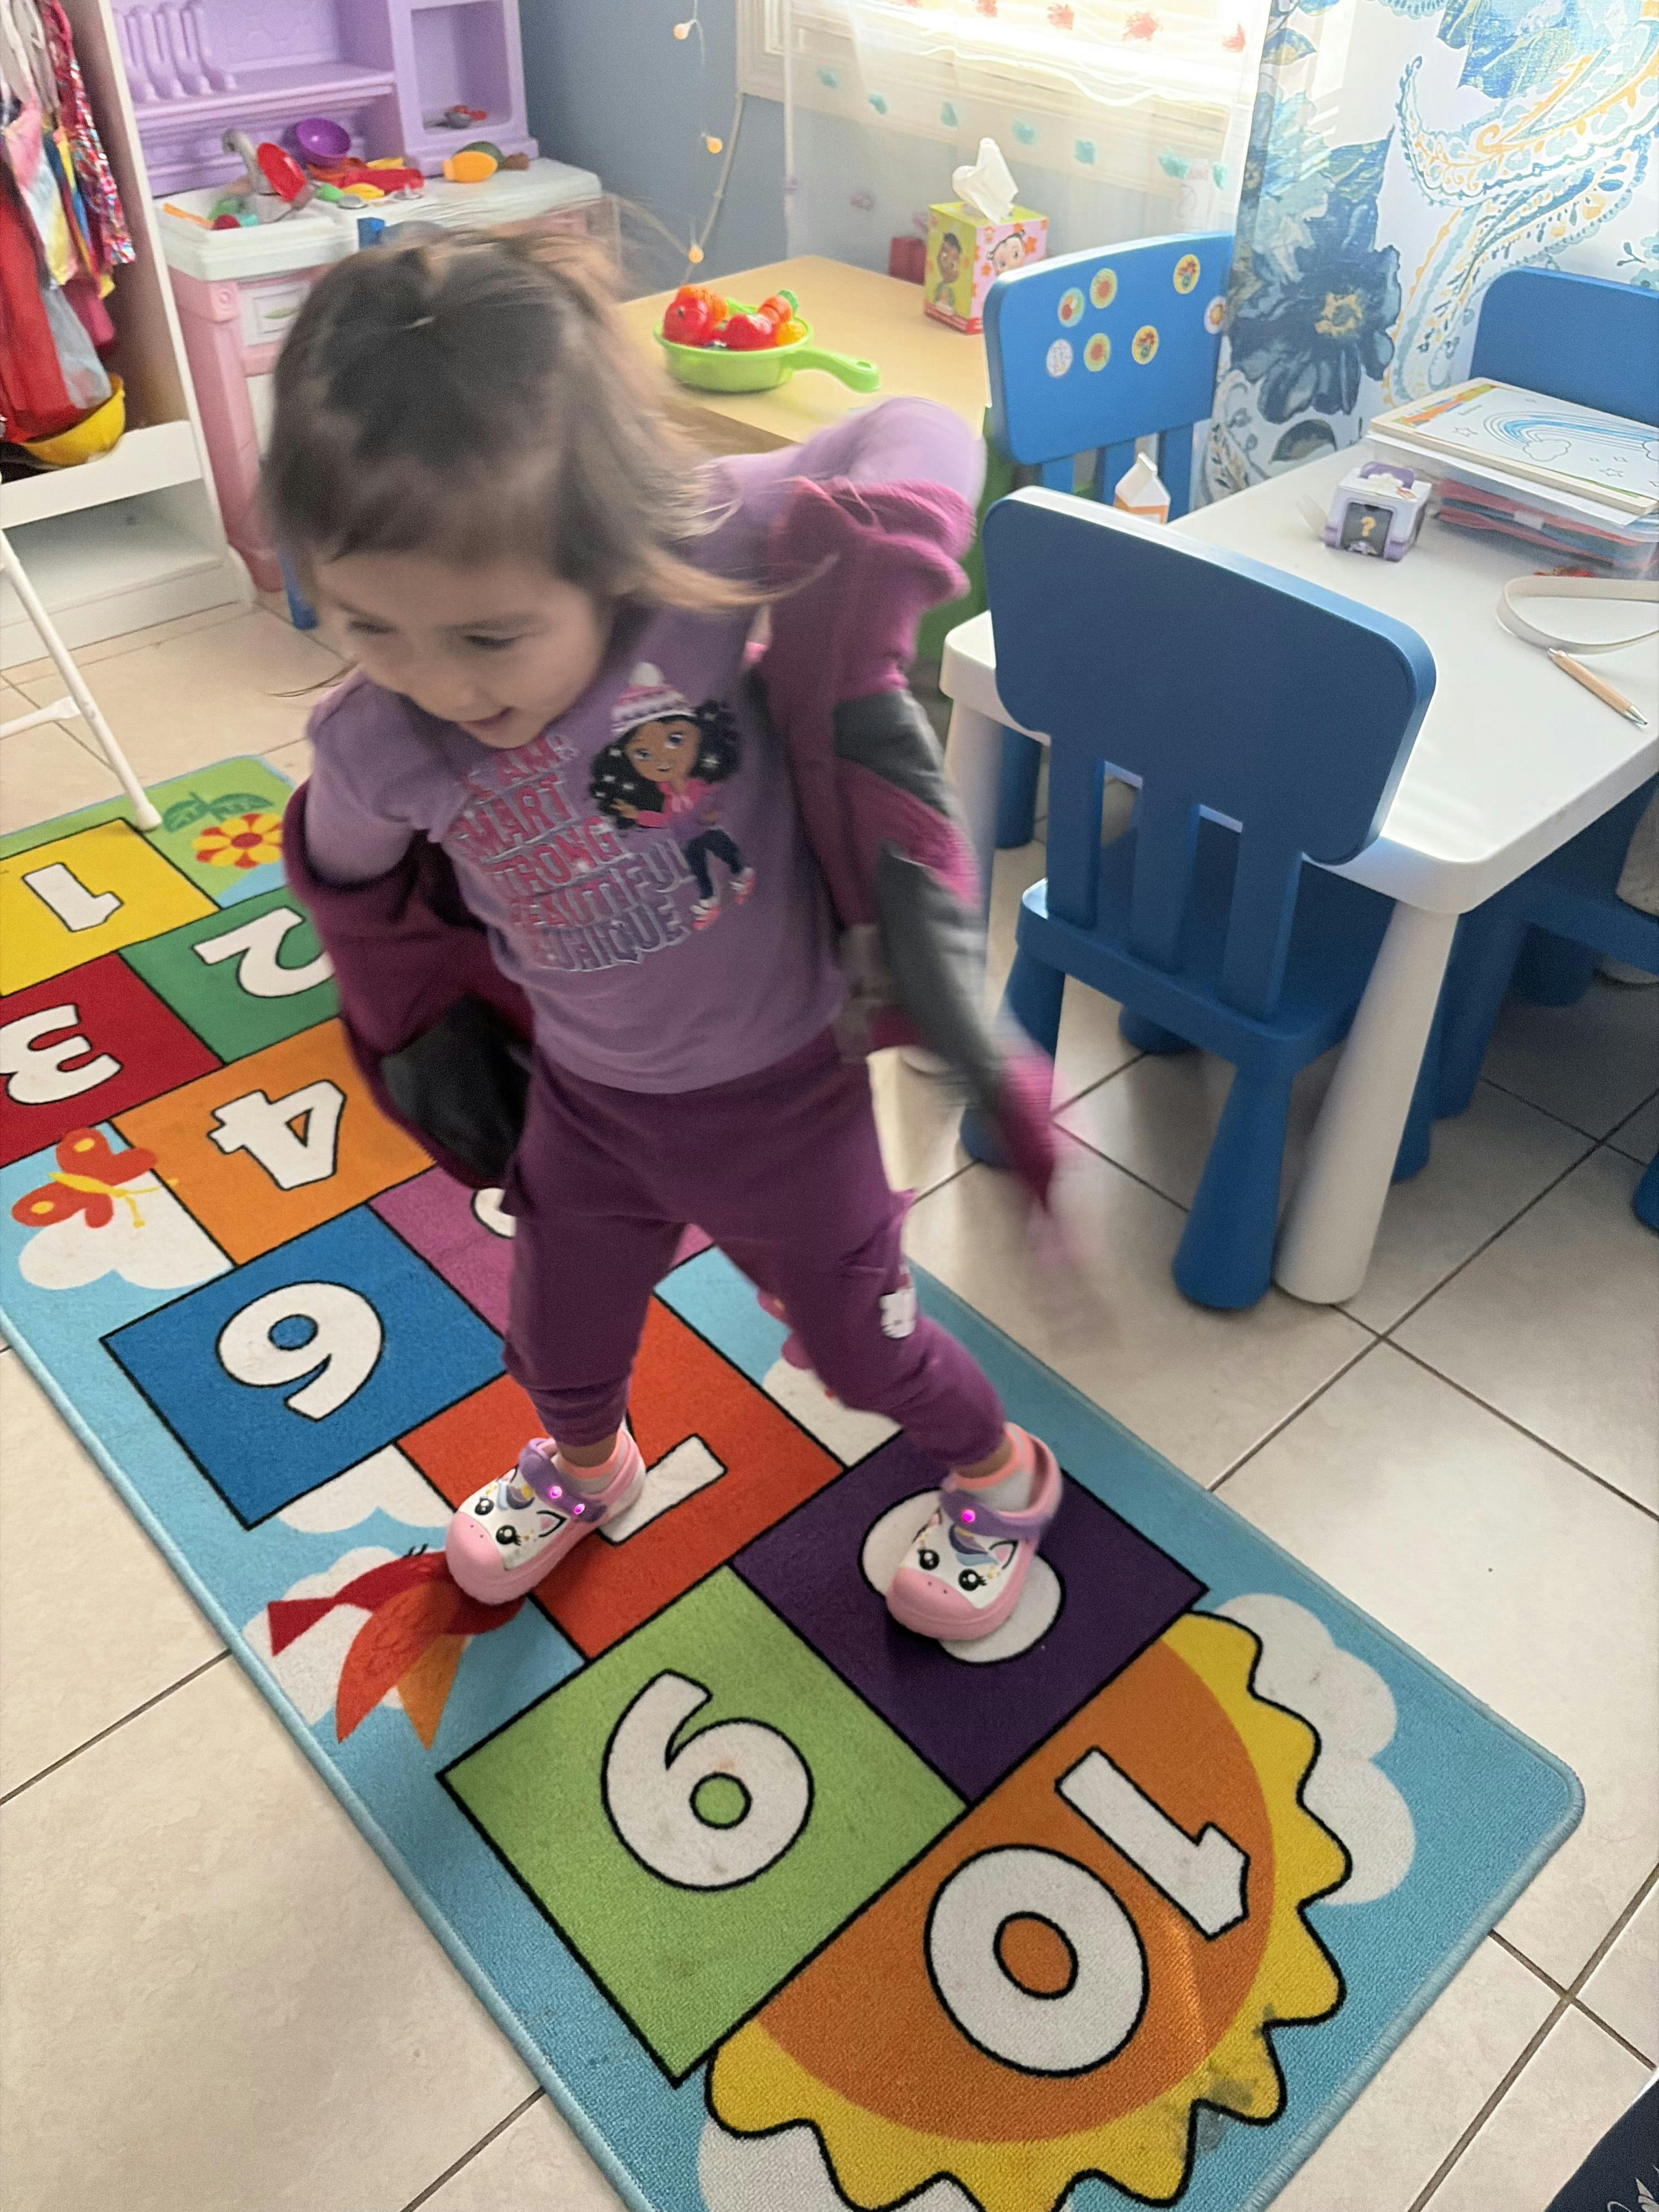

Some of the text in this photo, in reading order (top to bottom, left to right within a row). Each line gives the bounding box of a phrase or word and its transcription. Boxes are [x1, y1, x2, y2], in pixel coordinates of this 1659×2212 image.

[22, 862, 124, 933] 1
[477, 816, 625, 893] TRONG
[191, 906, 335, 998] 2
[0, 1003, 123, 1106] 3
[206, 1080, 347, 1191] 4
[923, 1745, 1251, 2079] 10
